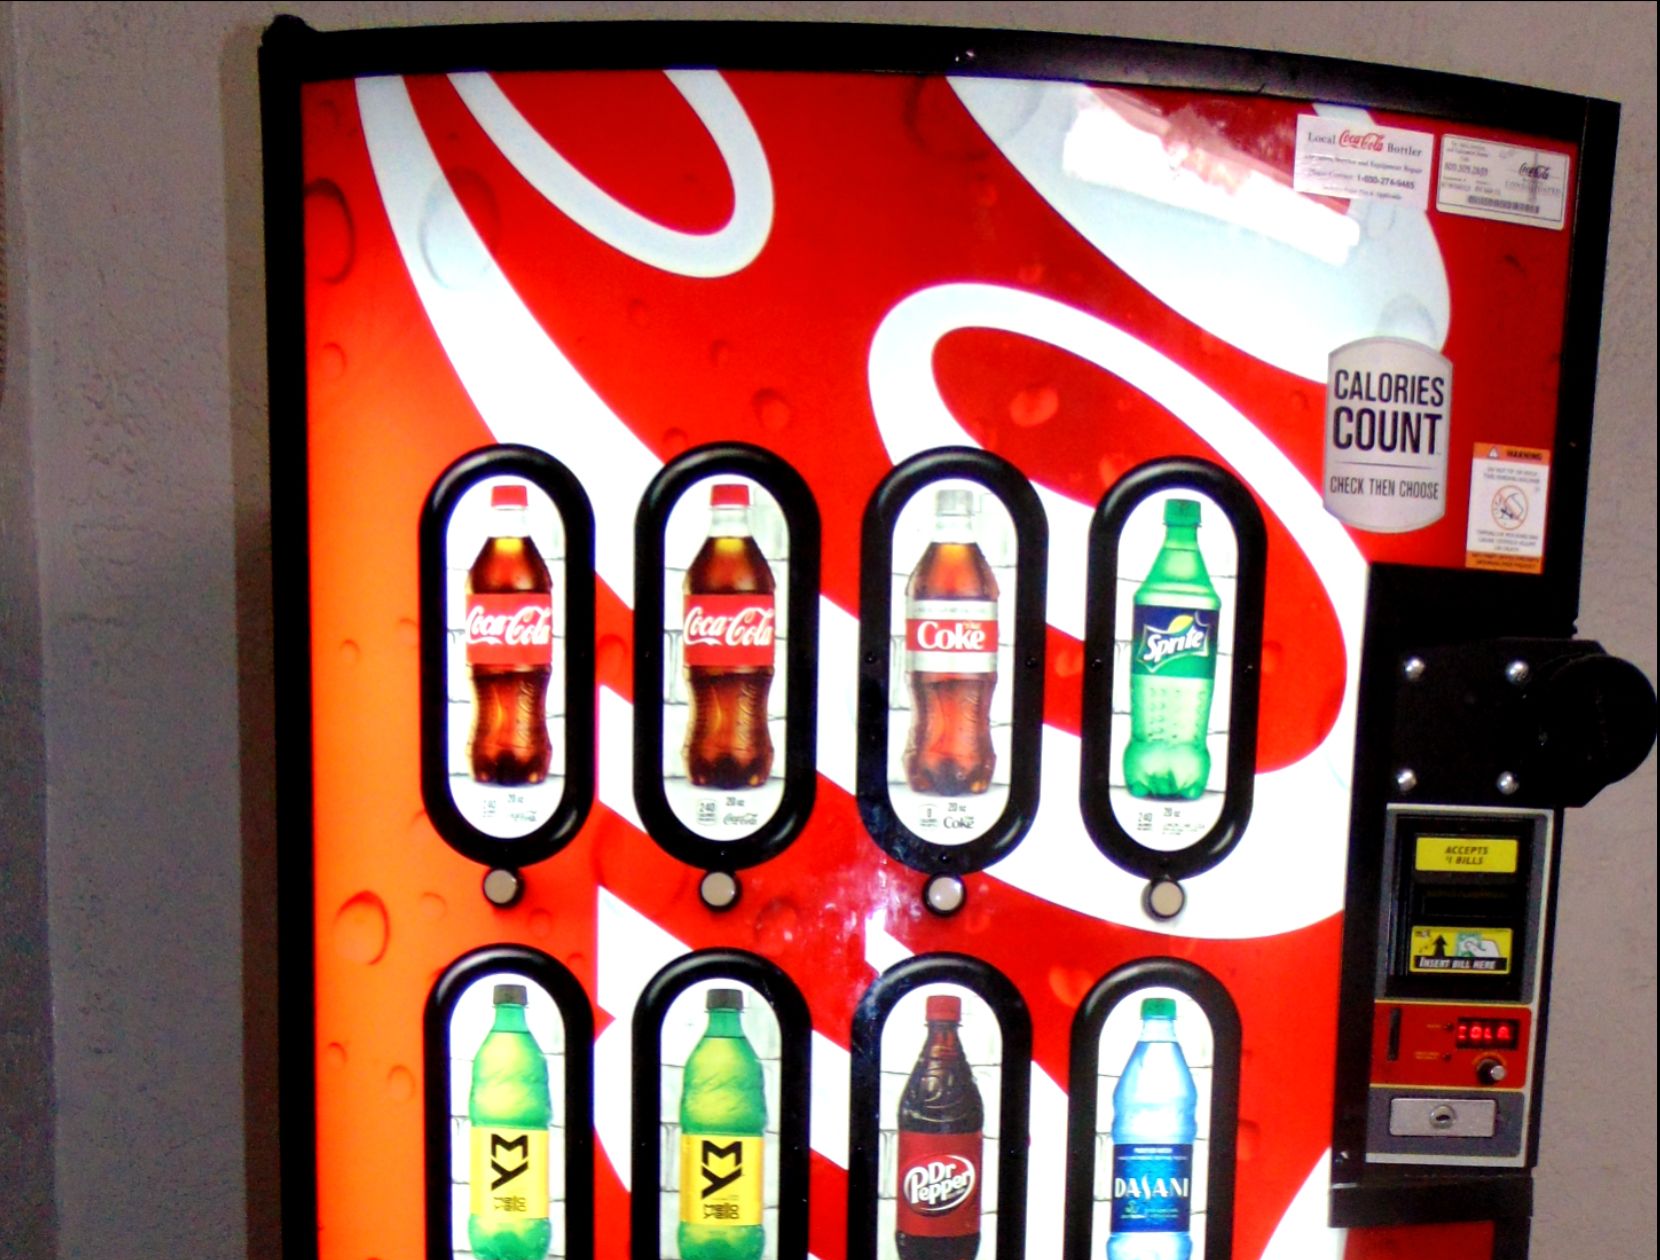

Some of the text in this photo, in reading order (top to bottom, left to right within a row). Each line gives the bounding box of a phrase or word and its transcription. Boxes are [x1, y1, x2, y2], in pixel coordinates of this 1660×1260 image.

[1308, 131, 1336, 145] Local
[1387, 142, 1422, 157] Bottler
[1334, 369, 1444, 407] CALORIES
[1333, 406, 1442, 455] COUNT
[1330, 476, 1439, 500] CHECK THEN CHOOSE
[917, 621, 985, 650] Coke
[1143, 625, 1204, 663] Sprite
[1445, 846, 1488, 855] ACCEPTS
[1455, 857, 1483, 865] BILLS
[904, 1166, 971, 1205] Pepper
[928, 1161, 957, 1184] Dr
[1115, 1174, 1188, 1200] DASANI
